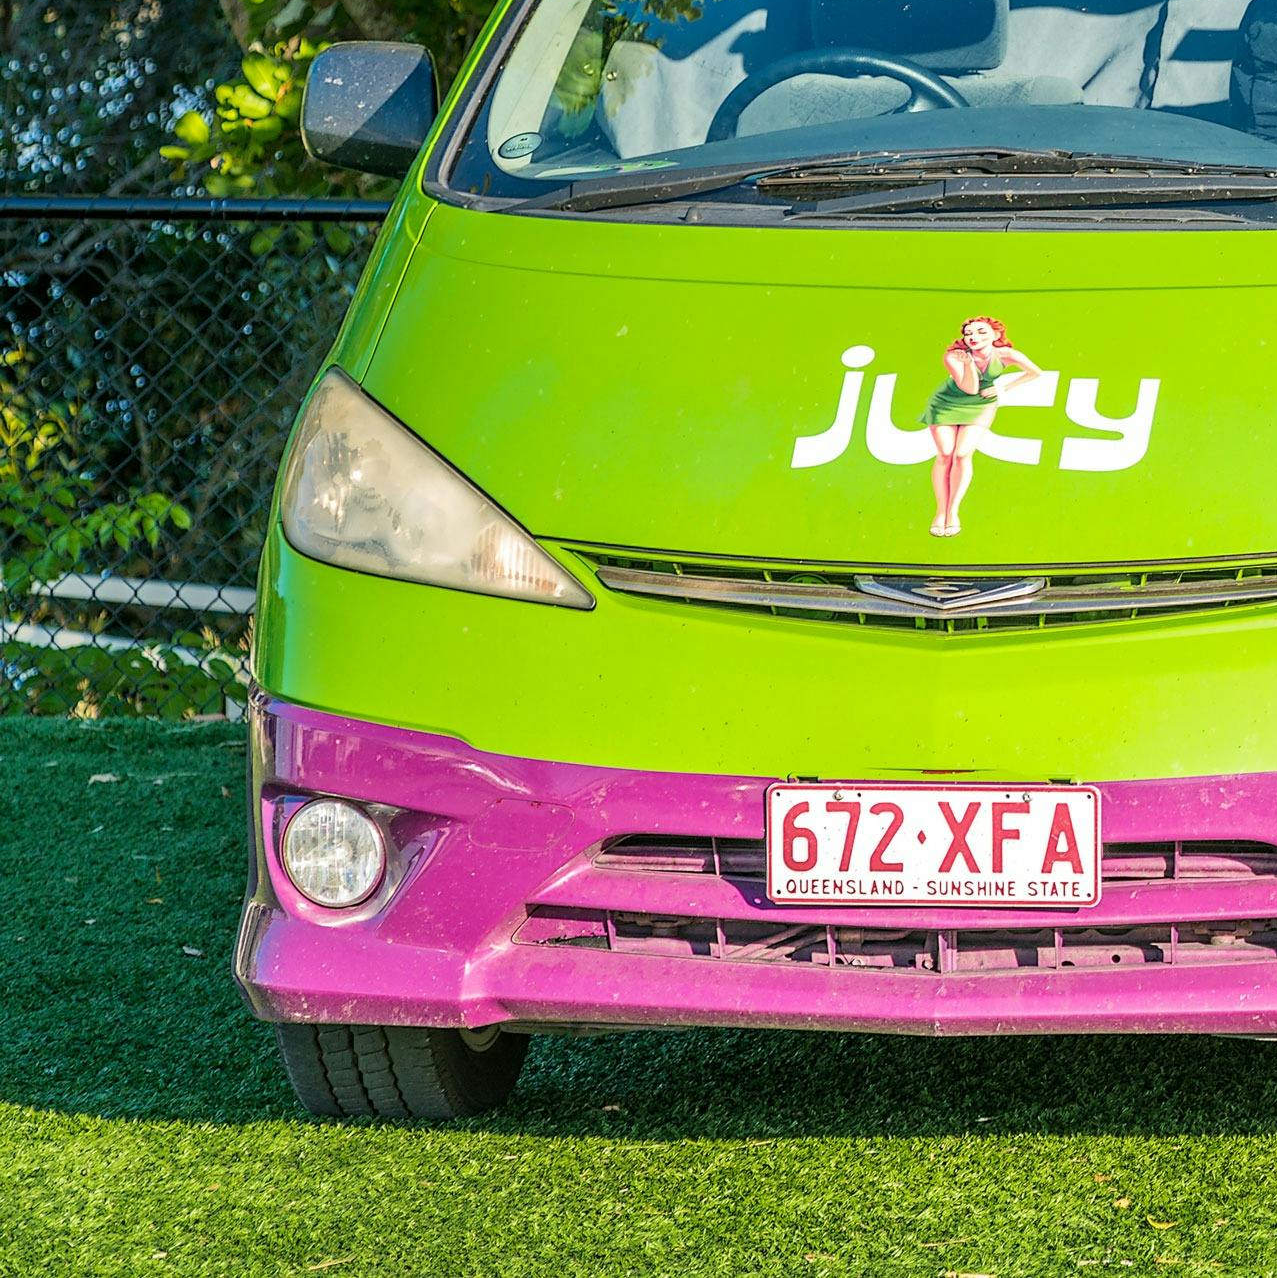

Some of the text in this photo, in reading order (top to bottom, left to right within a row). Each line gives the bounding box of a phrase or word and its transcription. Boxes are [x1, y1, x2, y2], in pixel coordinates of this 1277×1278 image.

[785, 879, 905, 896] QUEENSLAND
[926, 880, 1017, 897] SUNSHINE
[1027, 881, 1081, 897] STATE
